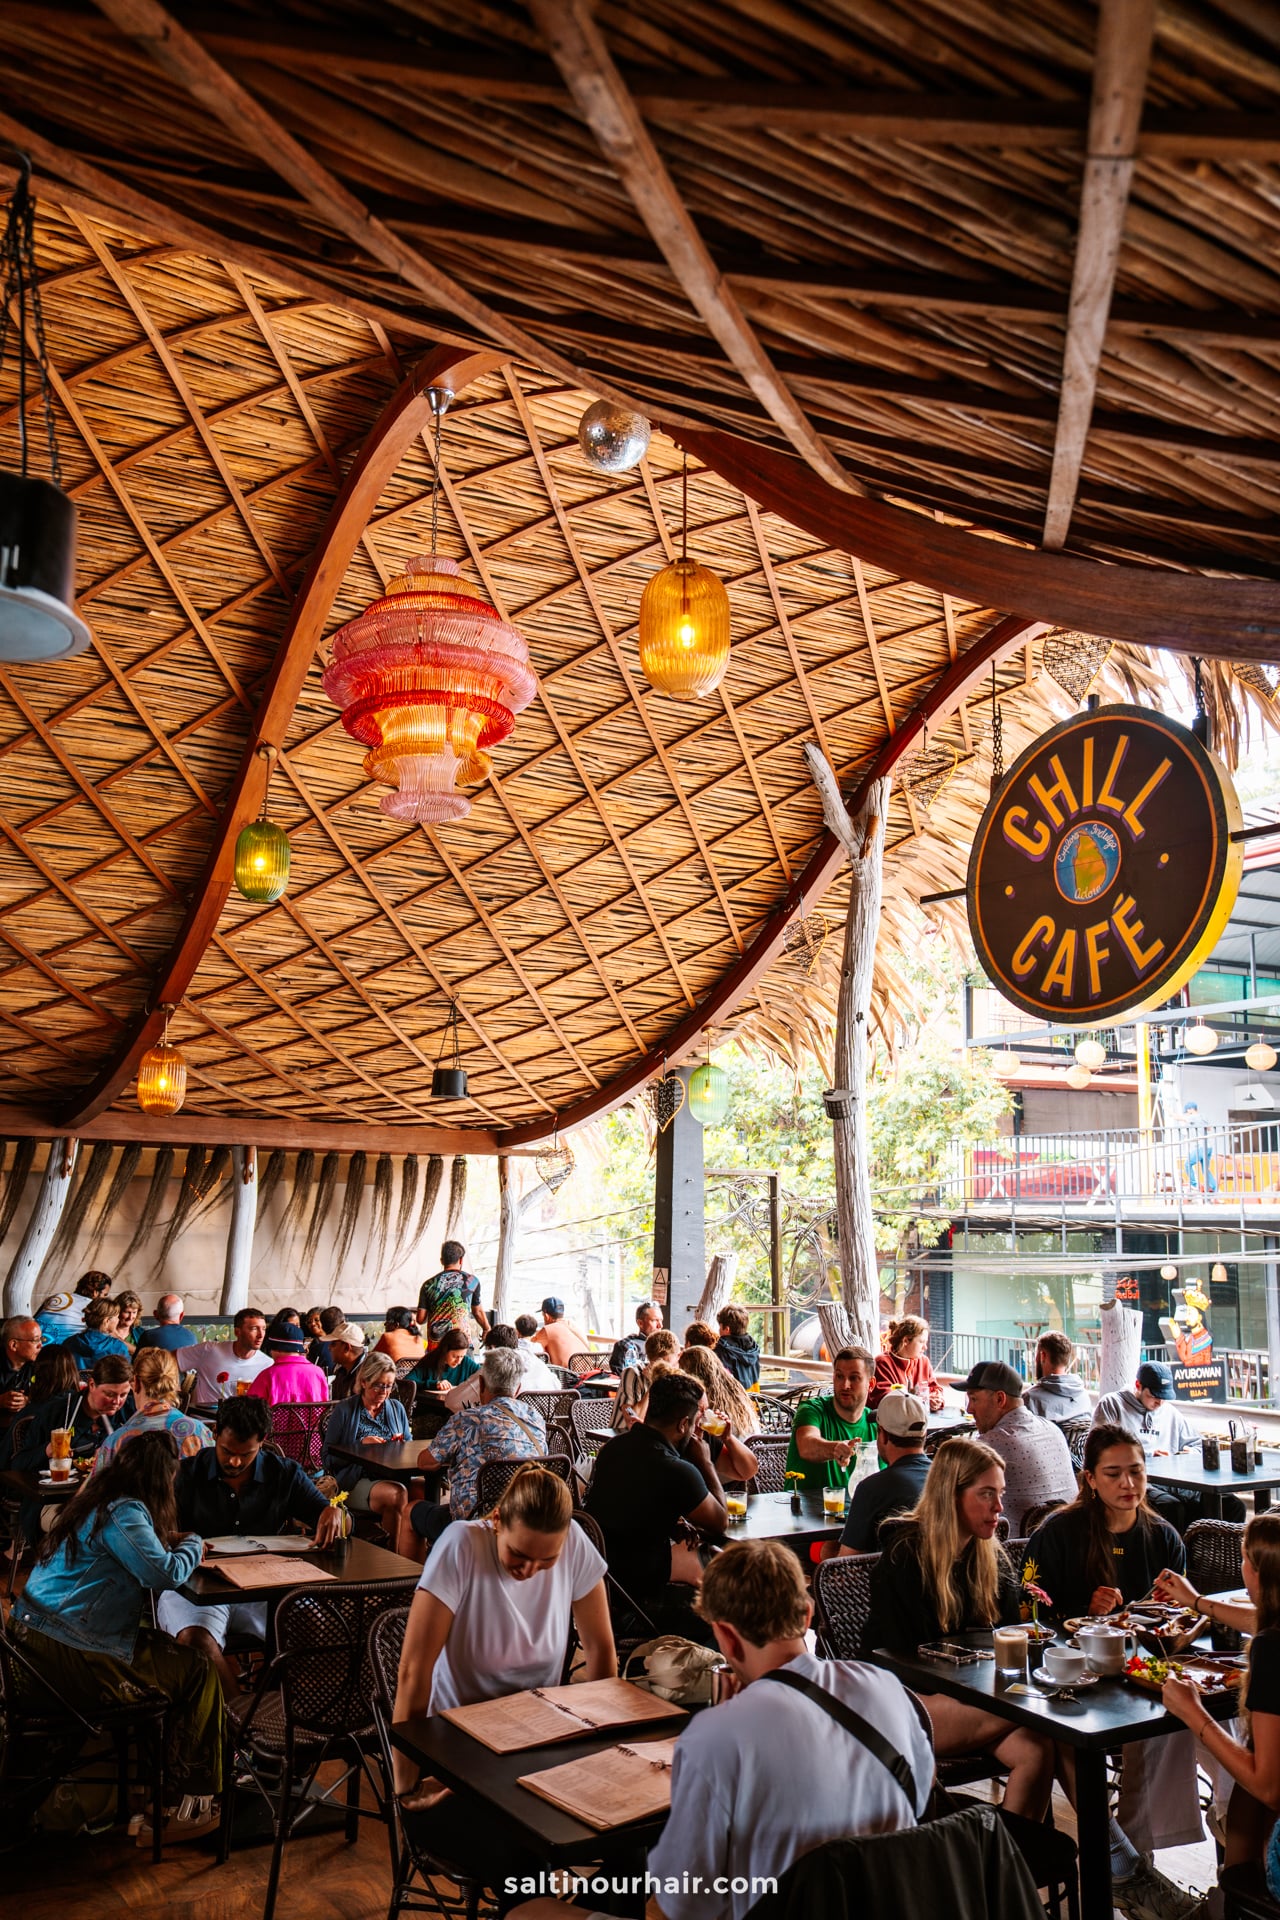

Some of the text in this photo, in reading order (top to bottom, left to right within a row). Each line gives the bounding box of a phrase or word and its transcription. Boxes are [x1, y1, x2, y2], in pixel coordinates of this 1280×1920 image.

[1003, 735, 1173, 860] CHILL
[1090, 823, 1118, 852] Indulge
[1011, 893, 1165, 1000] CAFÉ
[1115, 1289, 1140, 1300] Red Bull
[1174, 1366, 1222, 1381] AYUBOWAN
[1189, 1380, 1219, 1388] COLLECTION
